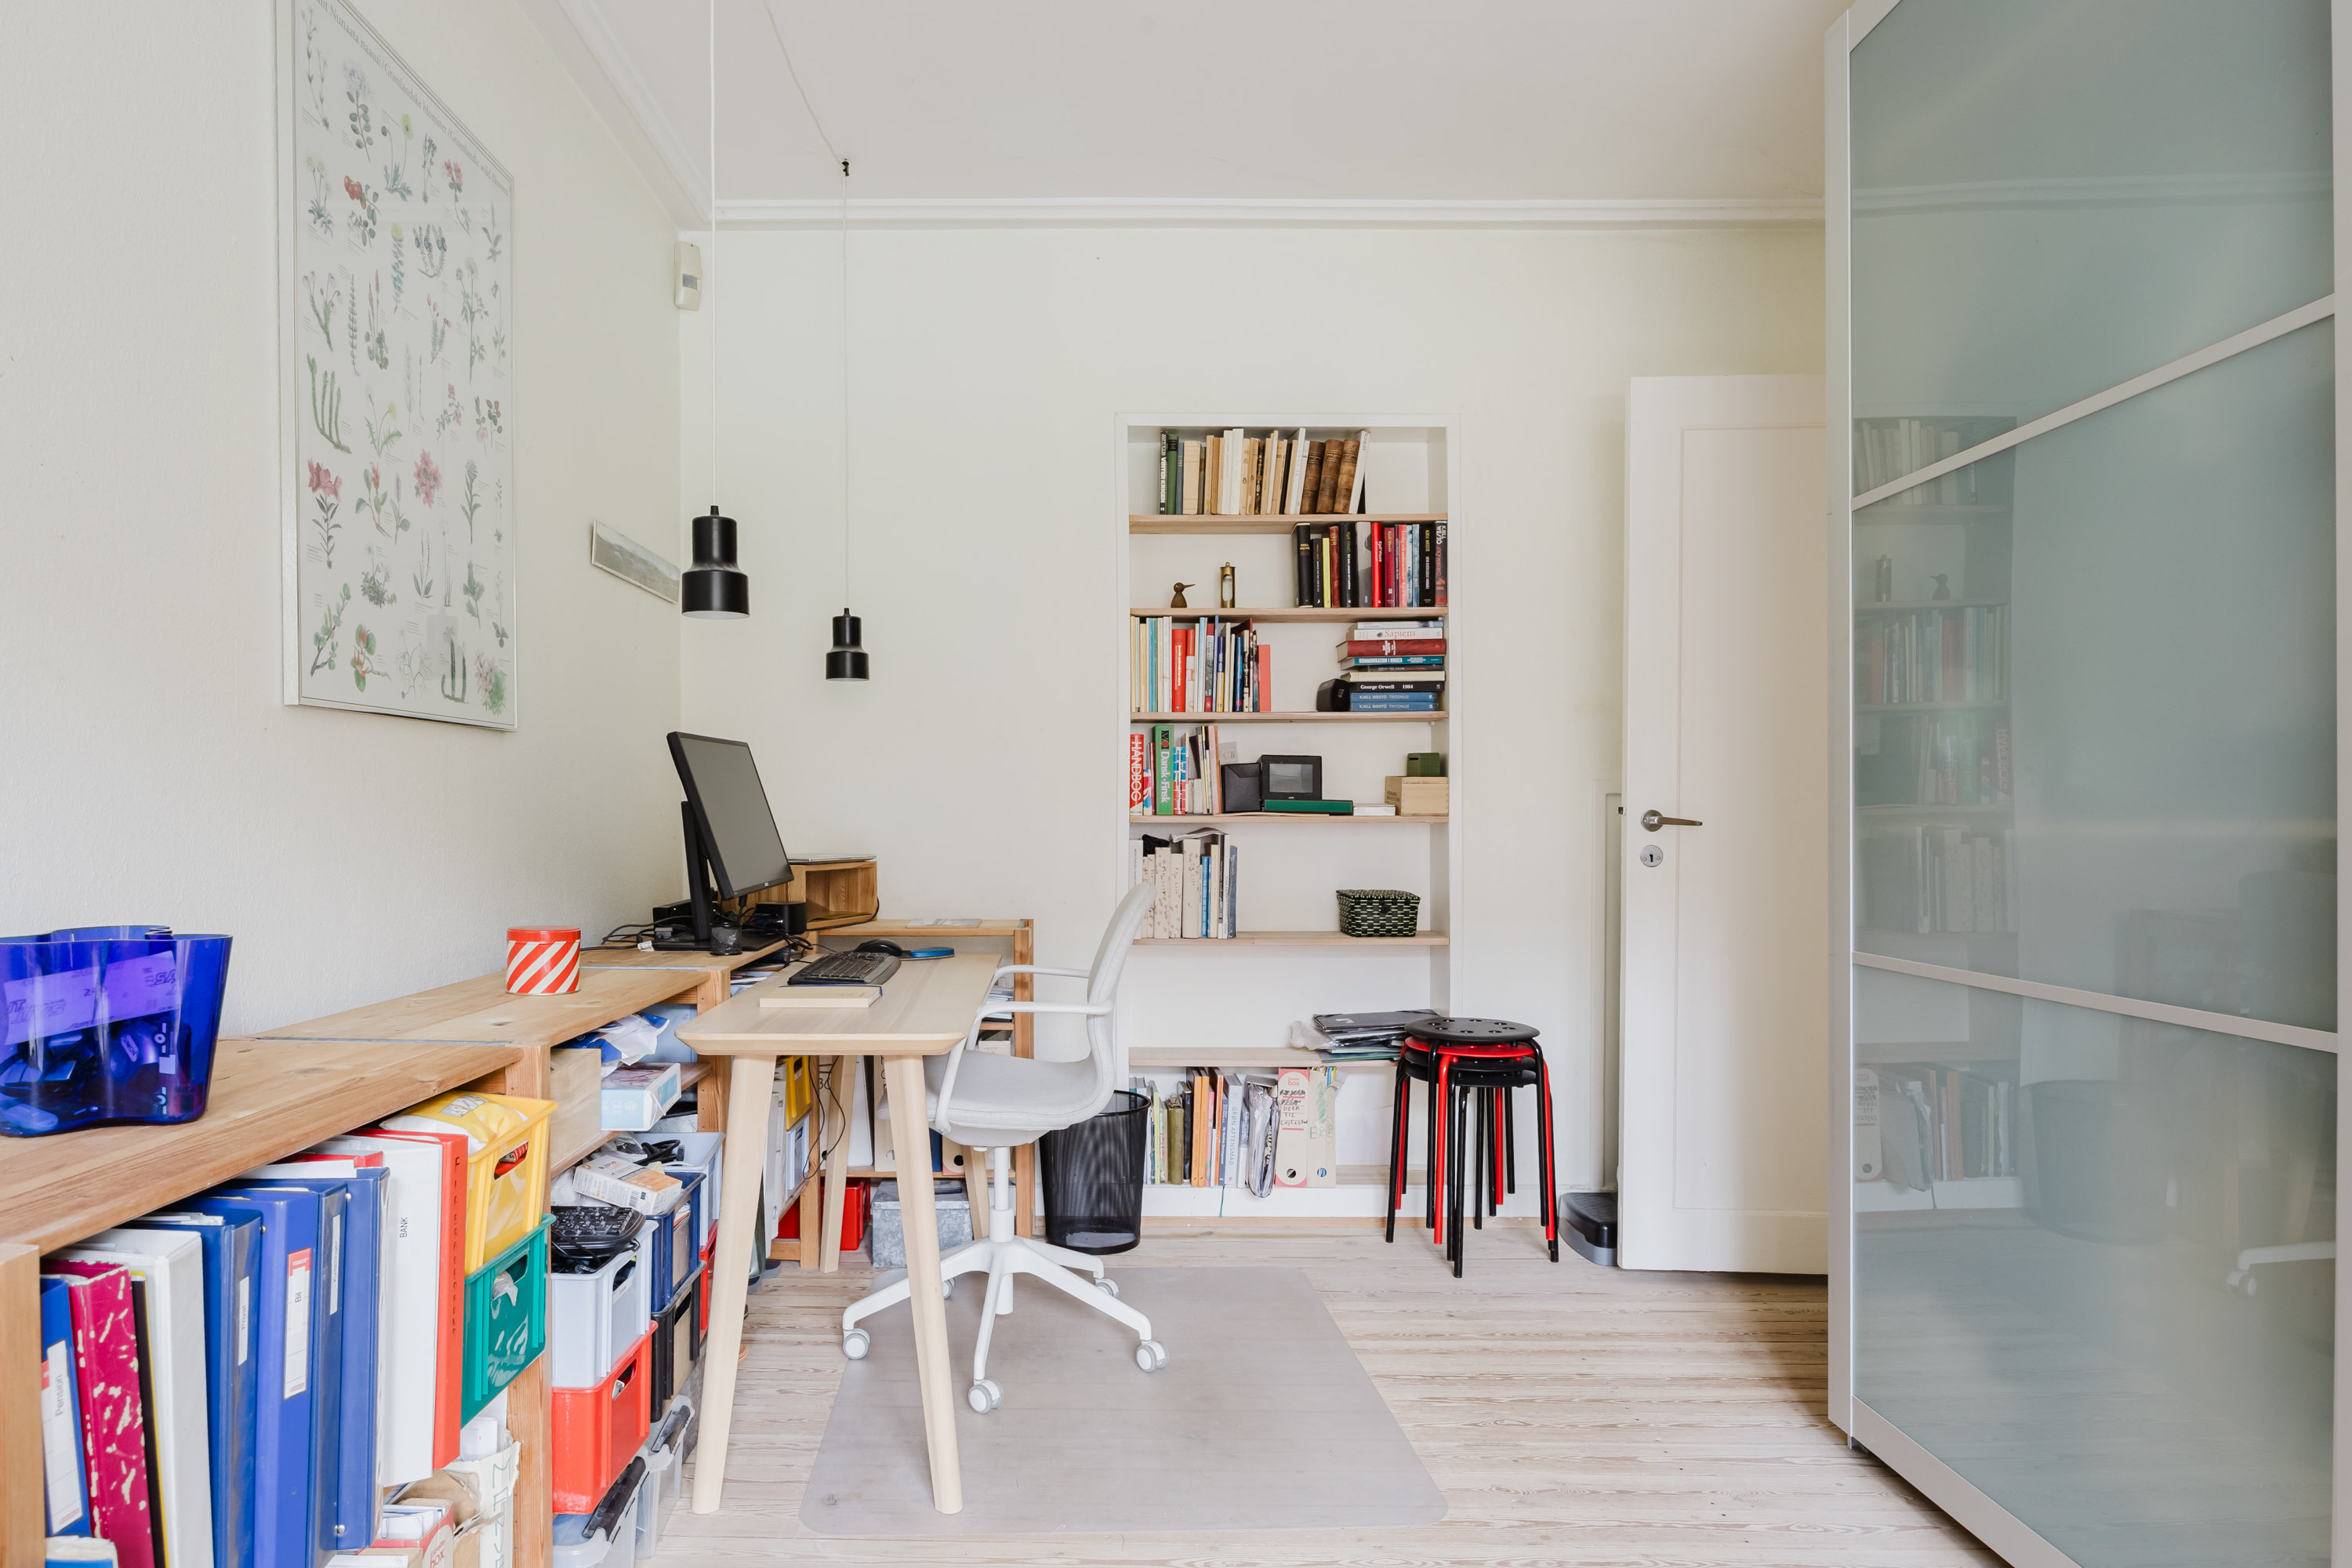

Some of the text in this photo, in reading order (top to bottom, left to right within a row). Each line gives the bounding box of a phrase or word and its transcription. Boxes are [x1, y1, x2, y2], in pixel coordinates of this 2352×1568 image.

[329, 4, 359, 44] Nunaata
[361, 40, 381, 67] naasui
[384, 63, 422, 109] Grønlandske
[423, 101, 447, 134] blomster
[1436, 578, 1446, 590] 41
[1385, 630, 1416, 639] Sapiens
[1131, 741, 1143, 801] HÅNDBOG
[1161, 751, 1171, 778] Dansk
[1160, 782, 1171, 804] Finsk
[55, 1374, 64, 1417] Pension
